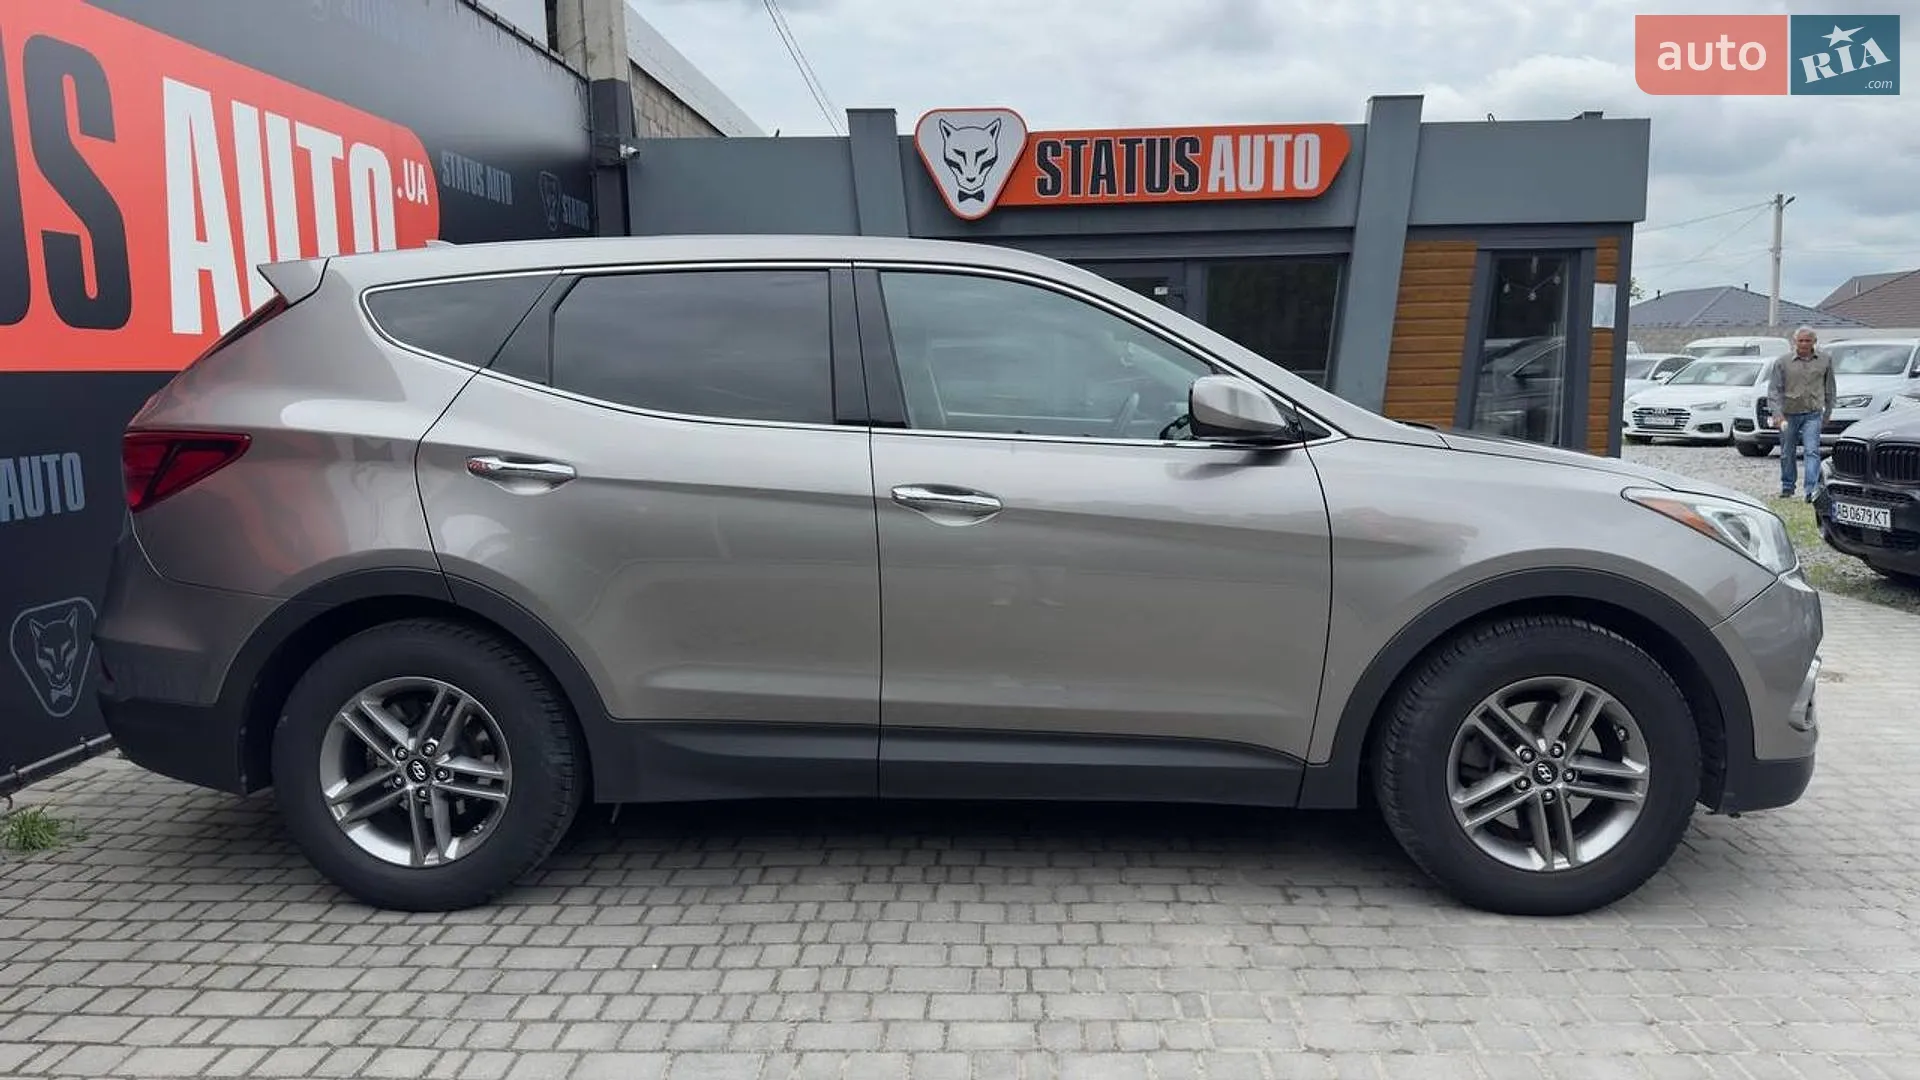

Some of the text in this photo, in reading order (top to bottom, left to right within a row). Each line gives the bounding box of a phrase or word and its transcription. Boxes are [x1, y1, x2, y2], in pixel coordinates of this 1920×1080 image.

[442, 151, 513, 205] STATUS AUTO
[1035, 132, 1321, 197] STATUS AUTO
[0, 453, 86, 521] AUTO
